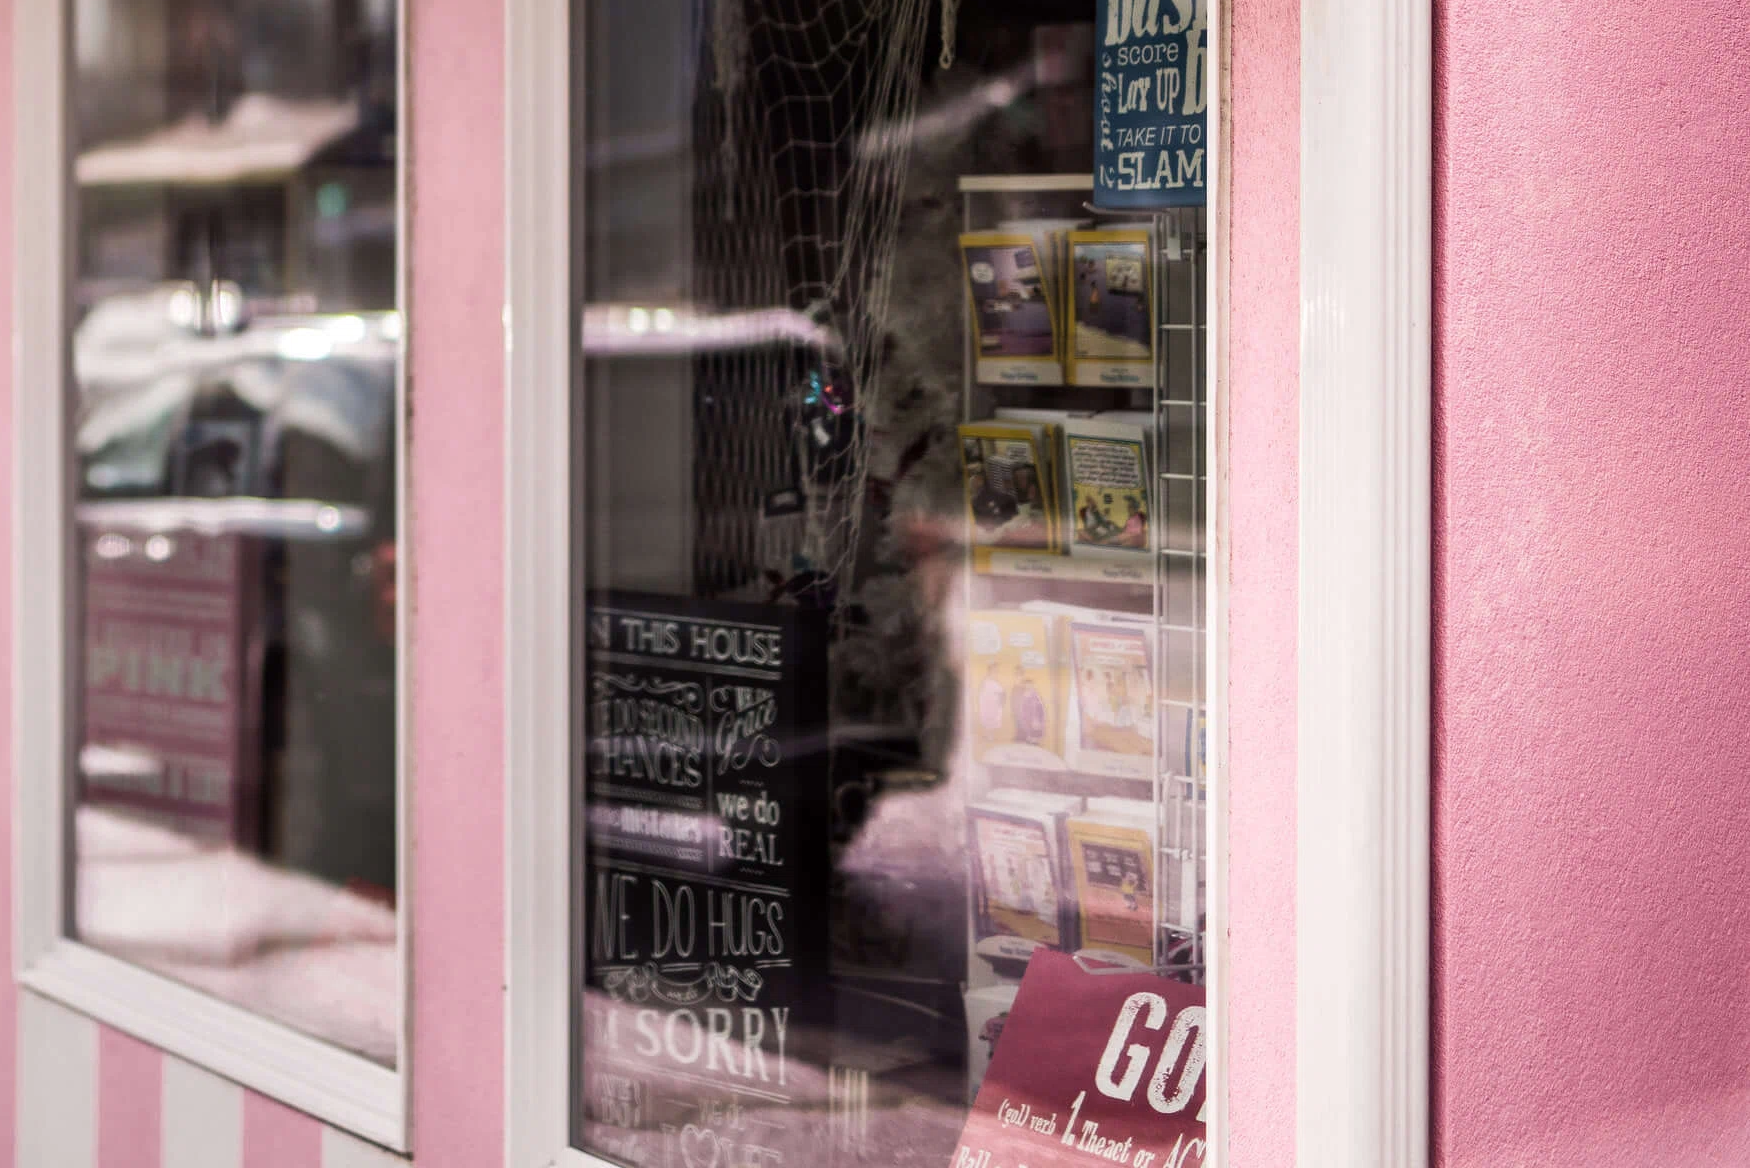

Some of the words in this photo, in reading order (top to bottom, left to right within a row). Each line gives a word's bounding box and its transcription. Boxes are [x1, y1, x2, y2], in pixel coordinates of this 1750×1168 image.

[1117, 42, 1178, 66] score
[1156, 68, 1181, 115] UP
[1117, 127, 1156, 148] TAKE
[1160, 126, 1177, 146] IT
[1179, 123, 1201, 145] TO
[1118, 148, 1205, 191] SLAM
[621, 618, 681, 655] THIS
[690, 625, 782, 666] HOUSE
[754, 789, 781, 827] do
[718, 825, 784, 866] REAL
[652, 879, 696, 958] DO
[707, 888, 785, 957] HUGS
[635, 1007, 790, 1086] SORRY
[1095, 992, 1207, 1122] GO
[1030, 1113, 1056, 1136] verb
